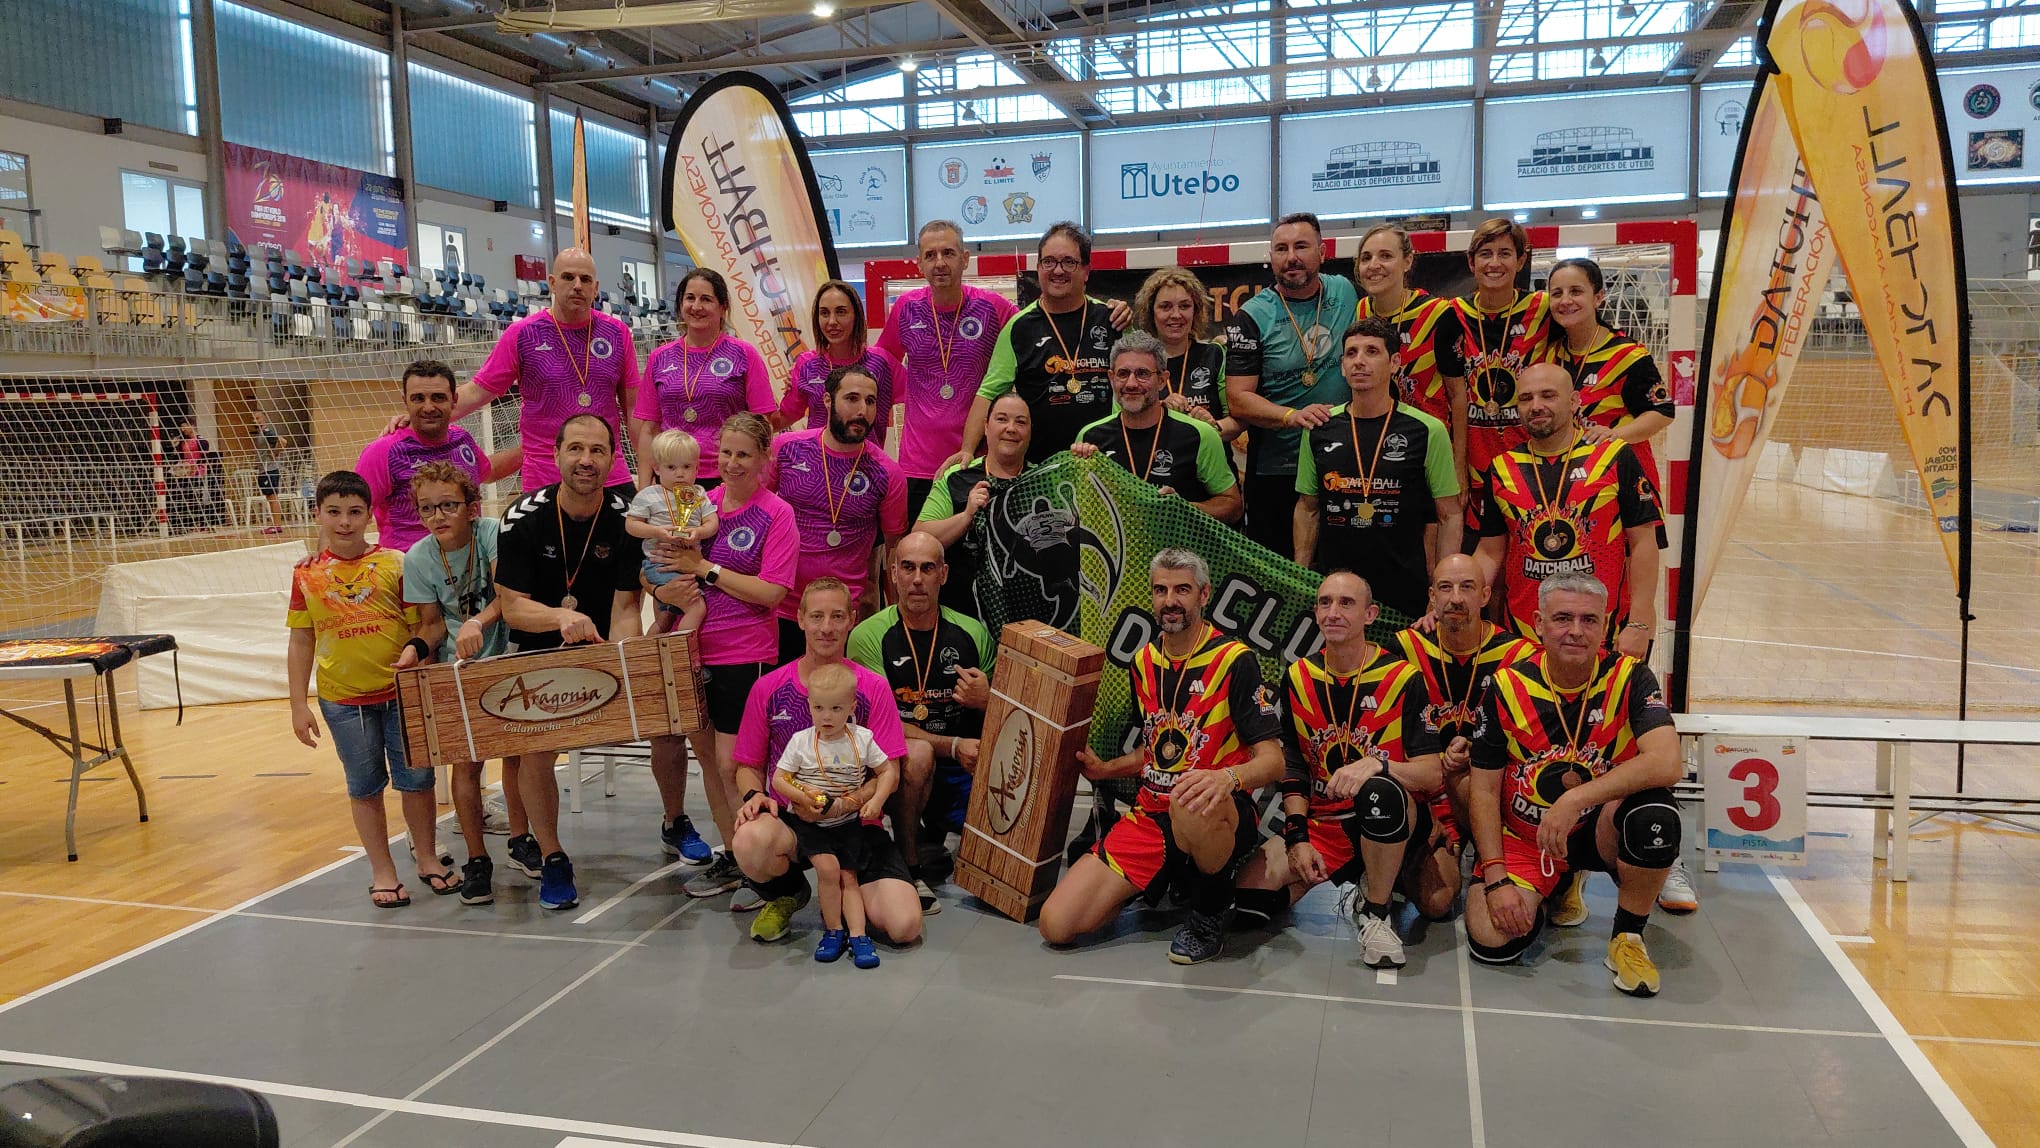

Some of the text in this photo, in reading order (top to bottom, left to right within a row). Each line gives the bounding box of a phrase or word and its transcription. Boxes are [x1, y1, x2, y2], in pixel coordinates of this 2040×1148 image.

[1151, 158, 1224, 171] Ayuntamiento
[1517, 166, 1548, 175] PALACIO
[1578, 161, 1615, 171] DEPORTES
[1630, 160, 1654, 168] UTEBO
[1151, 171, 1240, 197] Utebo
[1312, 181, 1340, 189] PALACIO
[1369, 175, 1405, 185] DEPORTES
[1418, 173, 1441, 182] UTEBO
[1750, 156, 1819, 356] DATCH
[1780, 219, 1829, 358] FEDERACIÓN
[1525, 554, 1592, 574] DATCHBALL
[338, 624, 382, 640] ESPAÑA
[500, 675, 602, 713] Aragonia
[503, 722, 561, 734] Calamocha
[989, 727, 1028, 823] Aragonia
[1726, 758, 1781, 832] 3
[1742, 839, 1768, 847] PISTA
